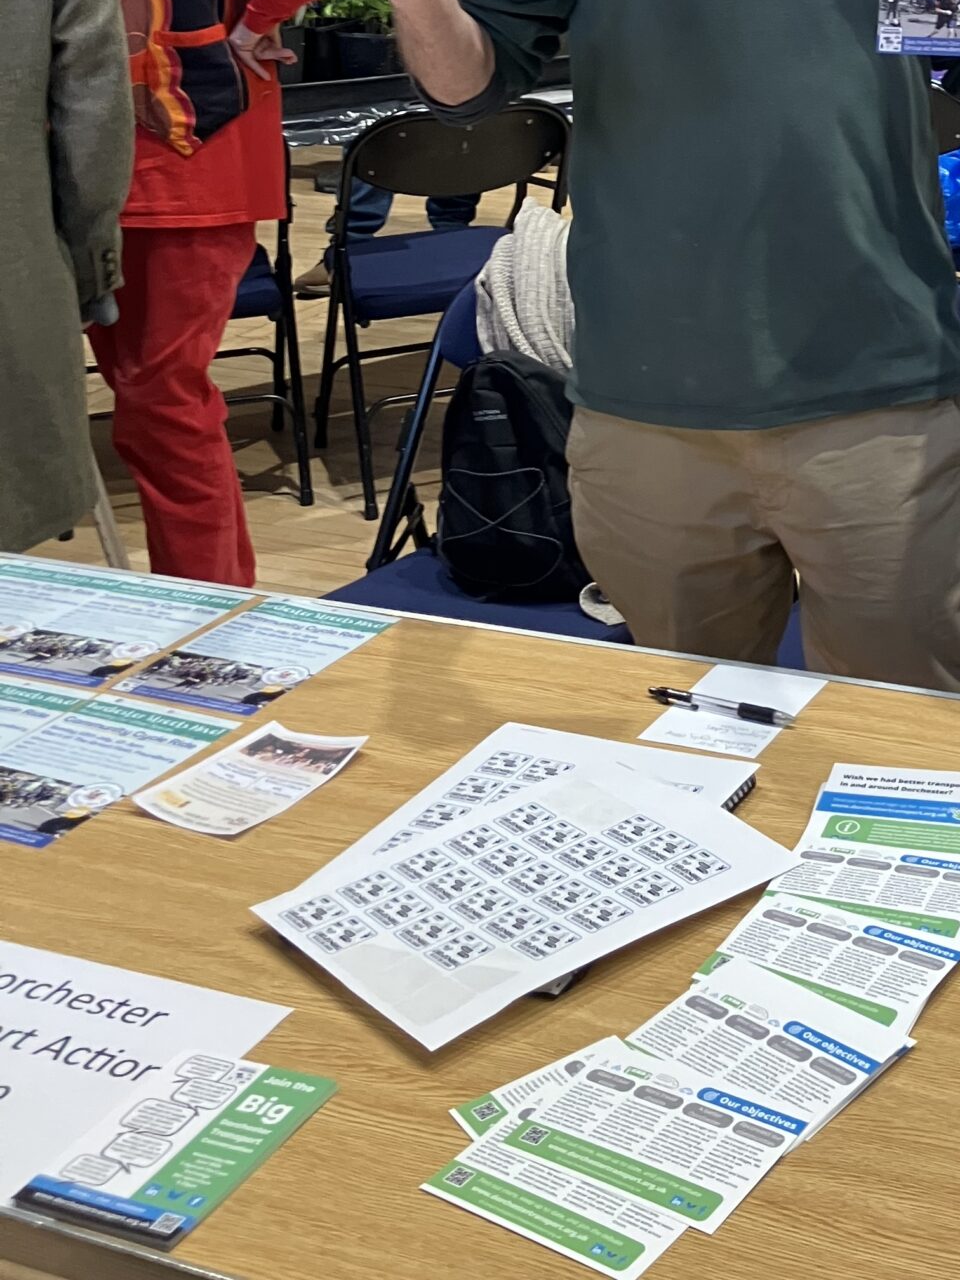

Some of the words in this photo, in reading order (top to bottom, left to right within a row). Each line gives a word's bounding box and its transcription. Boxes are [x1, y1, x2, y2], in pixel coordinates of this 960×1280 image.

[883, 932, 903, 941] Our
[905, 937, 955, 958] objectives
[803, 1031, 822, 1044] Our
[822, 1041, 871, 1069] objectives
[235, 1095, 295, 1124] Big
[720, 1096, 740, 1108] Our
[741, 1104, 797, 1129] objectives
